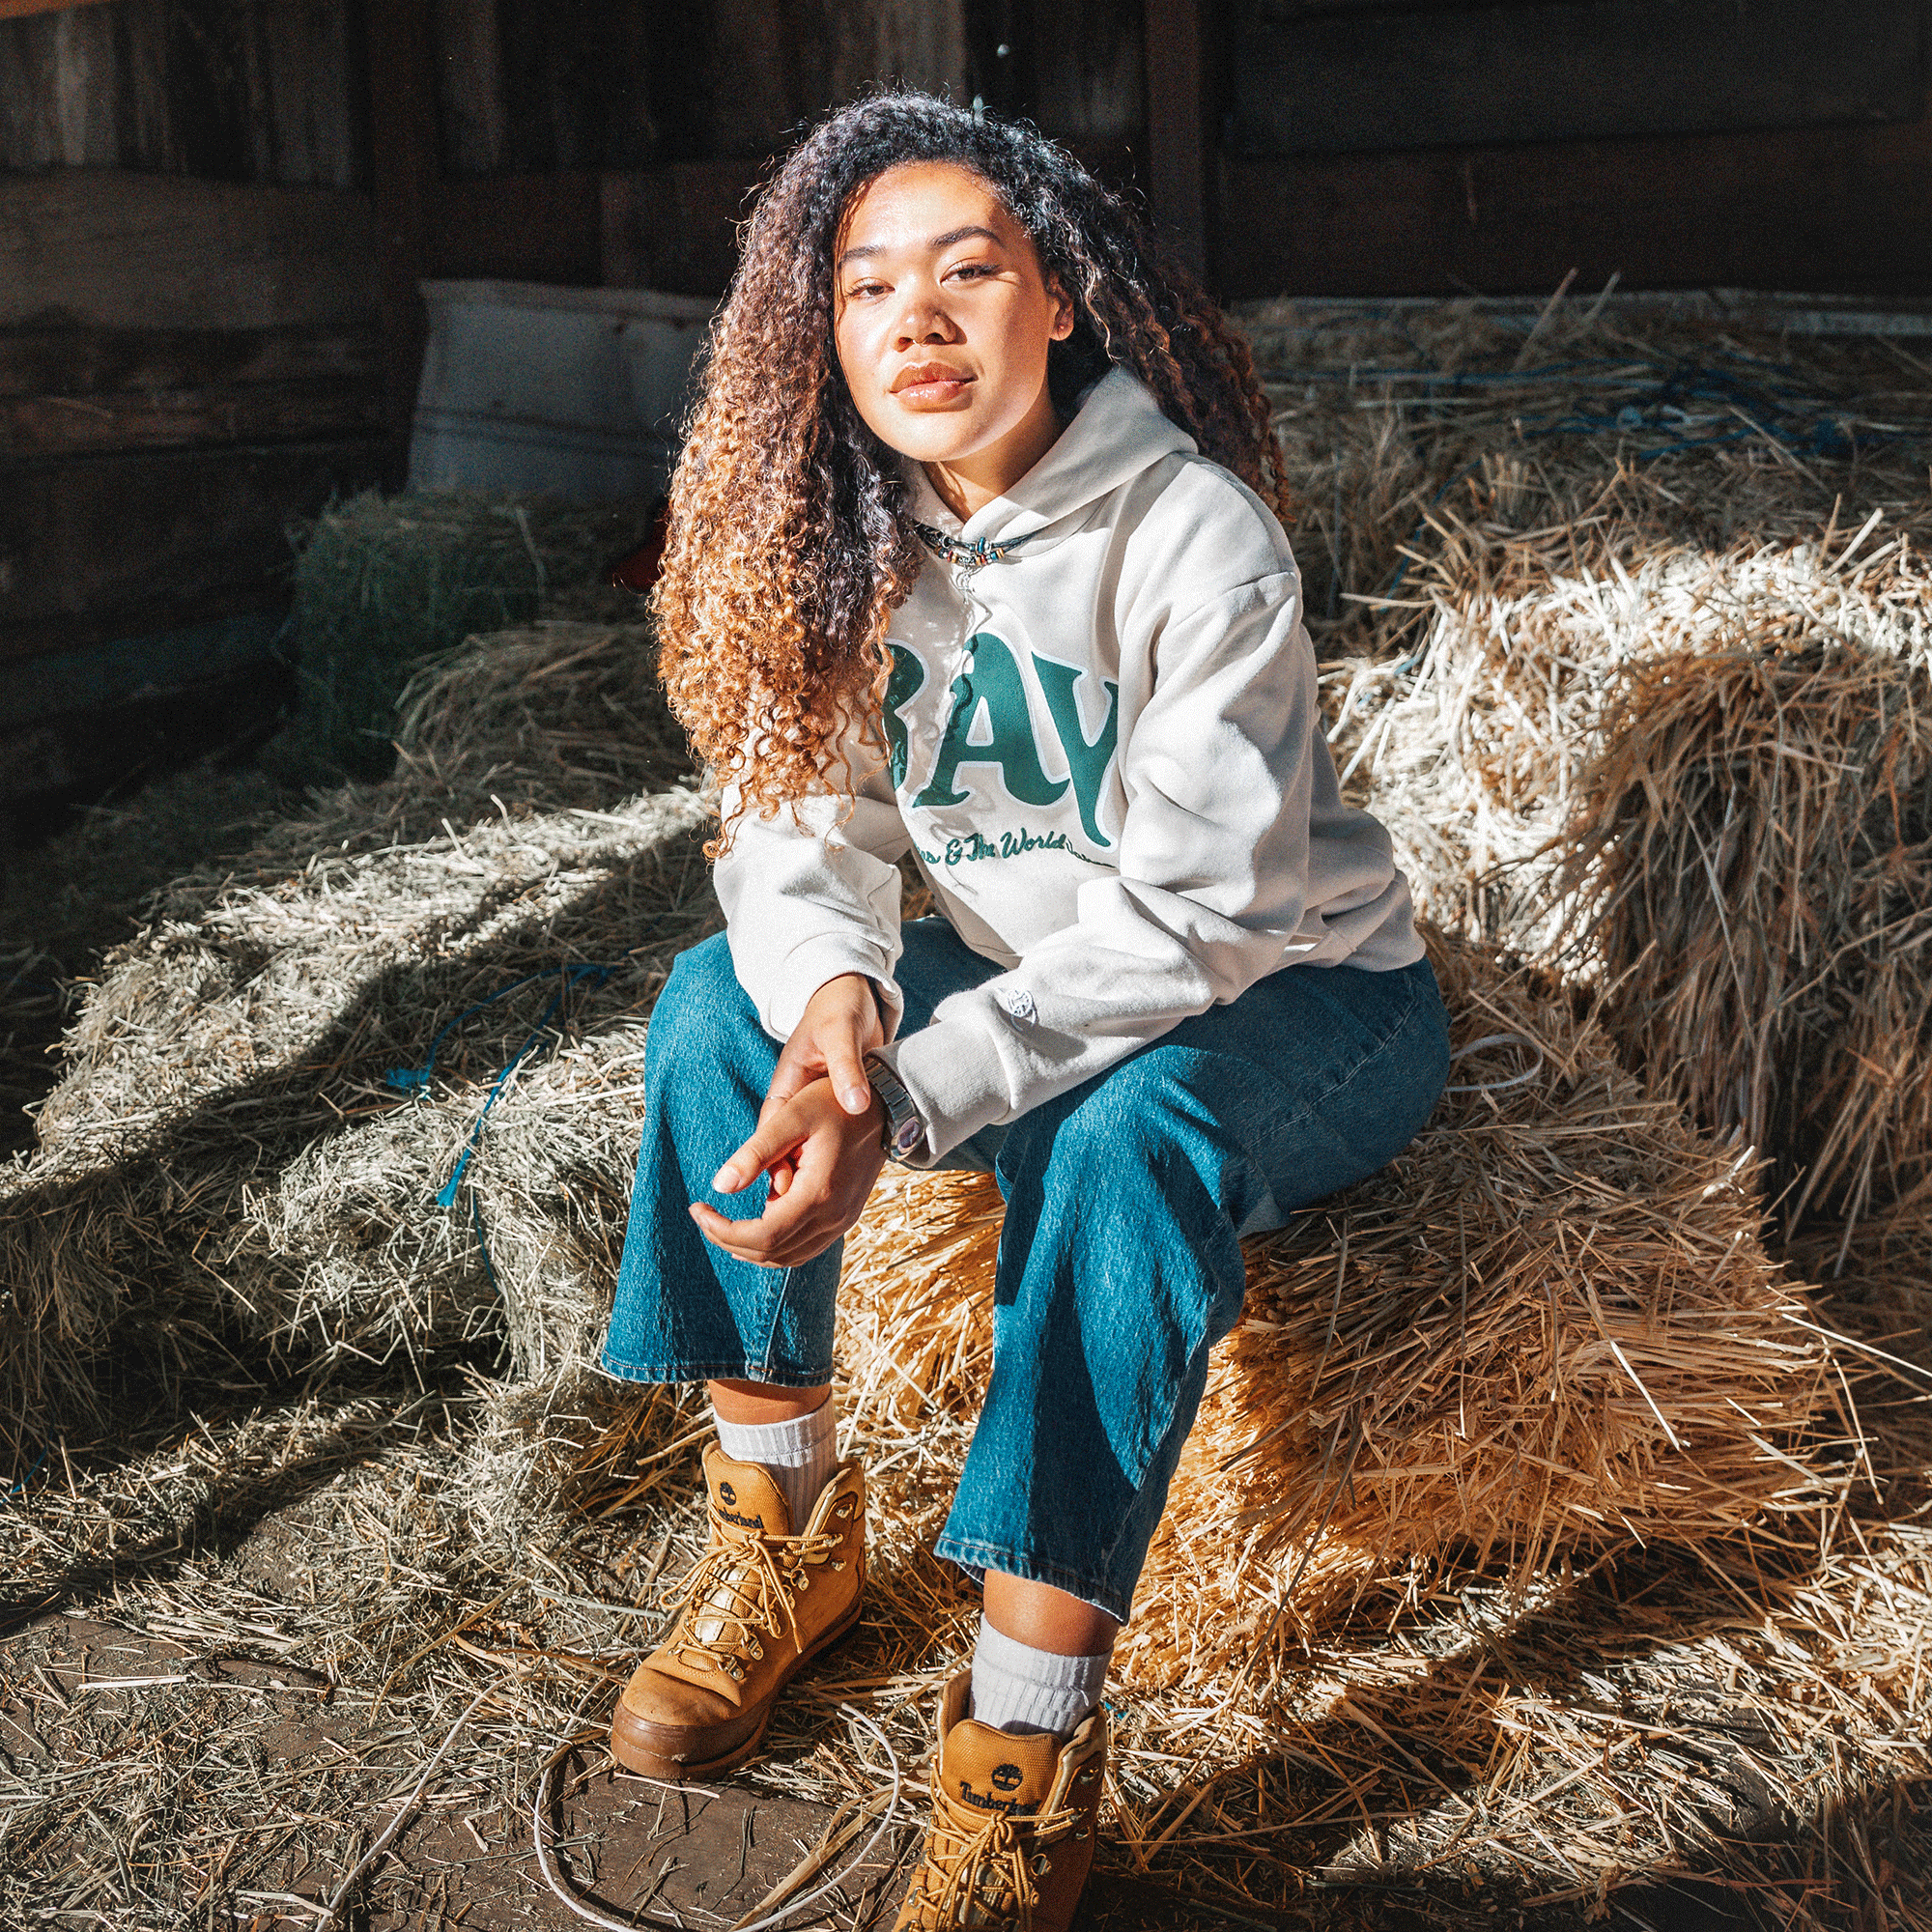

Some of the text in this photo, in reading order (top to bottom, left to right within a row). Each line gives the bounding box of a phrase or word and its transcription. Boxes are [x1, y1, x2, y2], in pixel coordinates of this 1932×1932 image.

[945, 838, 964, 866] &
[964, 832, 996, 862] The
[999, 827, 1067, 859] World
